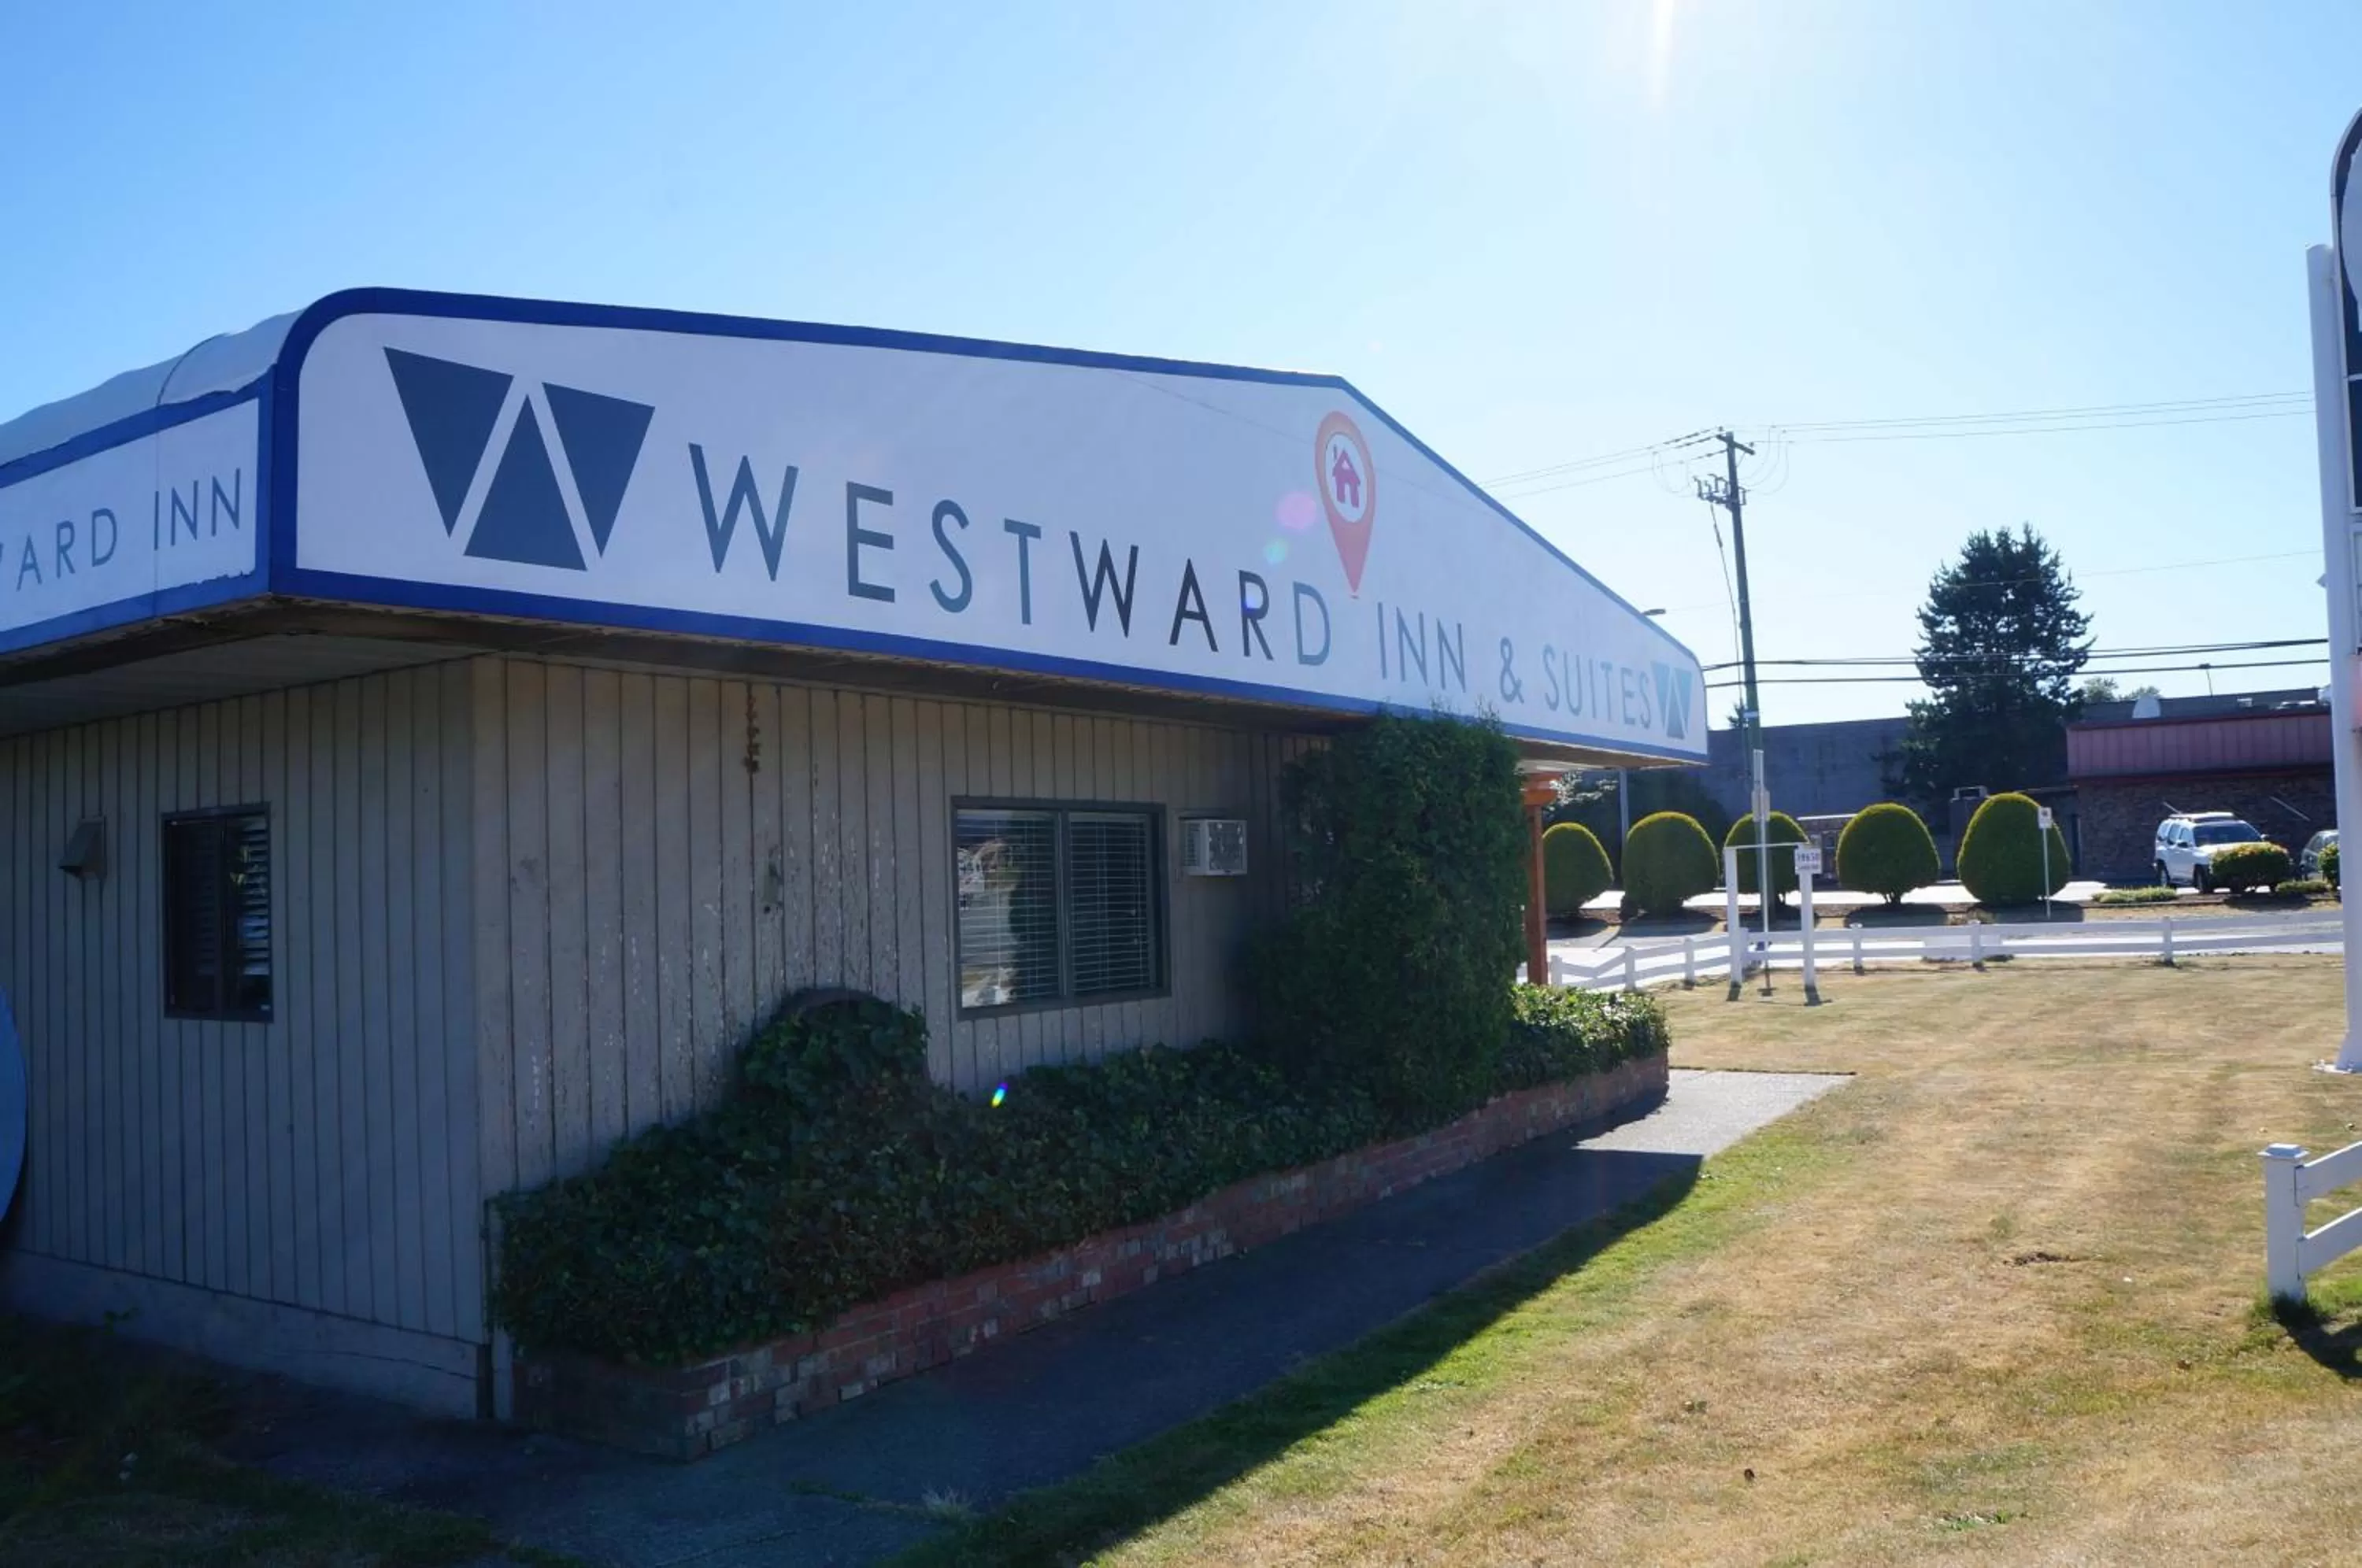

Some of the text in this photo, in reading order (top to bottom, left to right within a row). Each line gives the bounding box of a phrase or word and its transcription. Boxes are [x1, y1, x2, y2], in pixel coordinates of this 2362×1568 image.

[0, 468, 240, 591] ARD INN
[688, 442, 1652, 730] WESTWARD INN & SUITES
